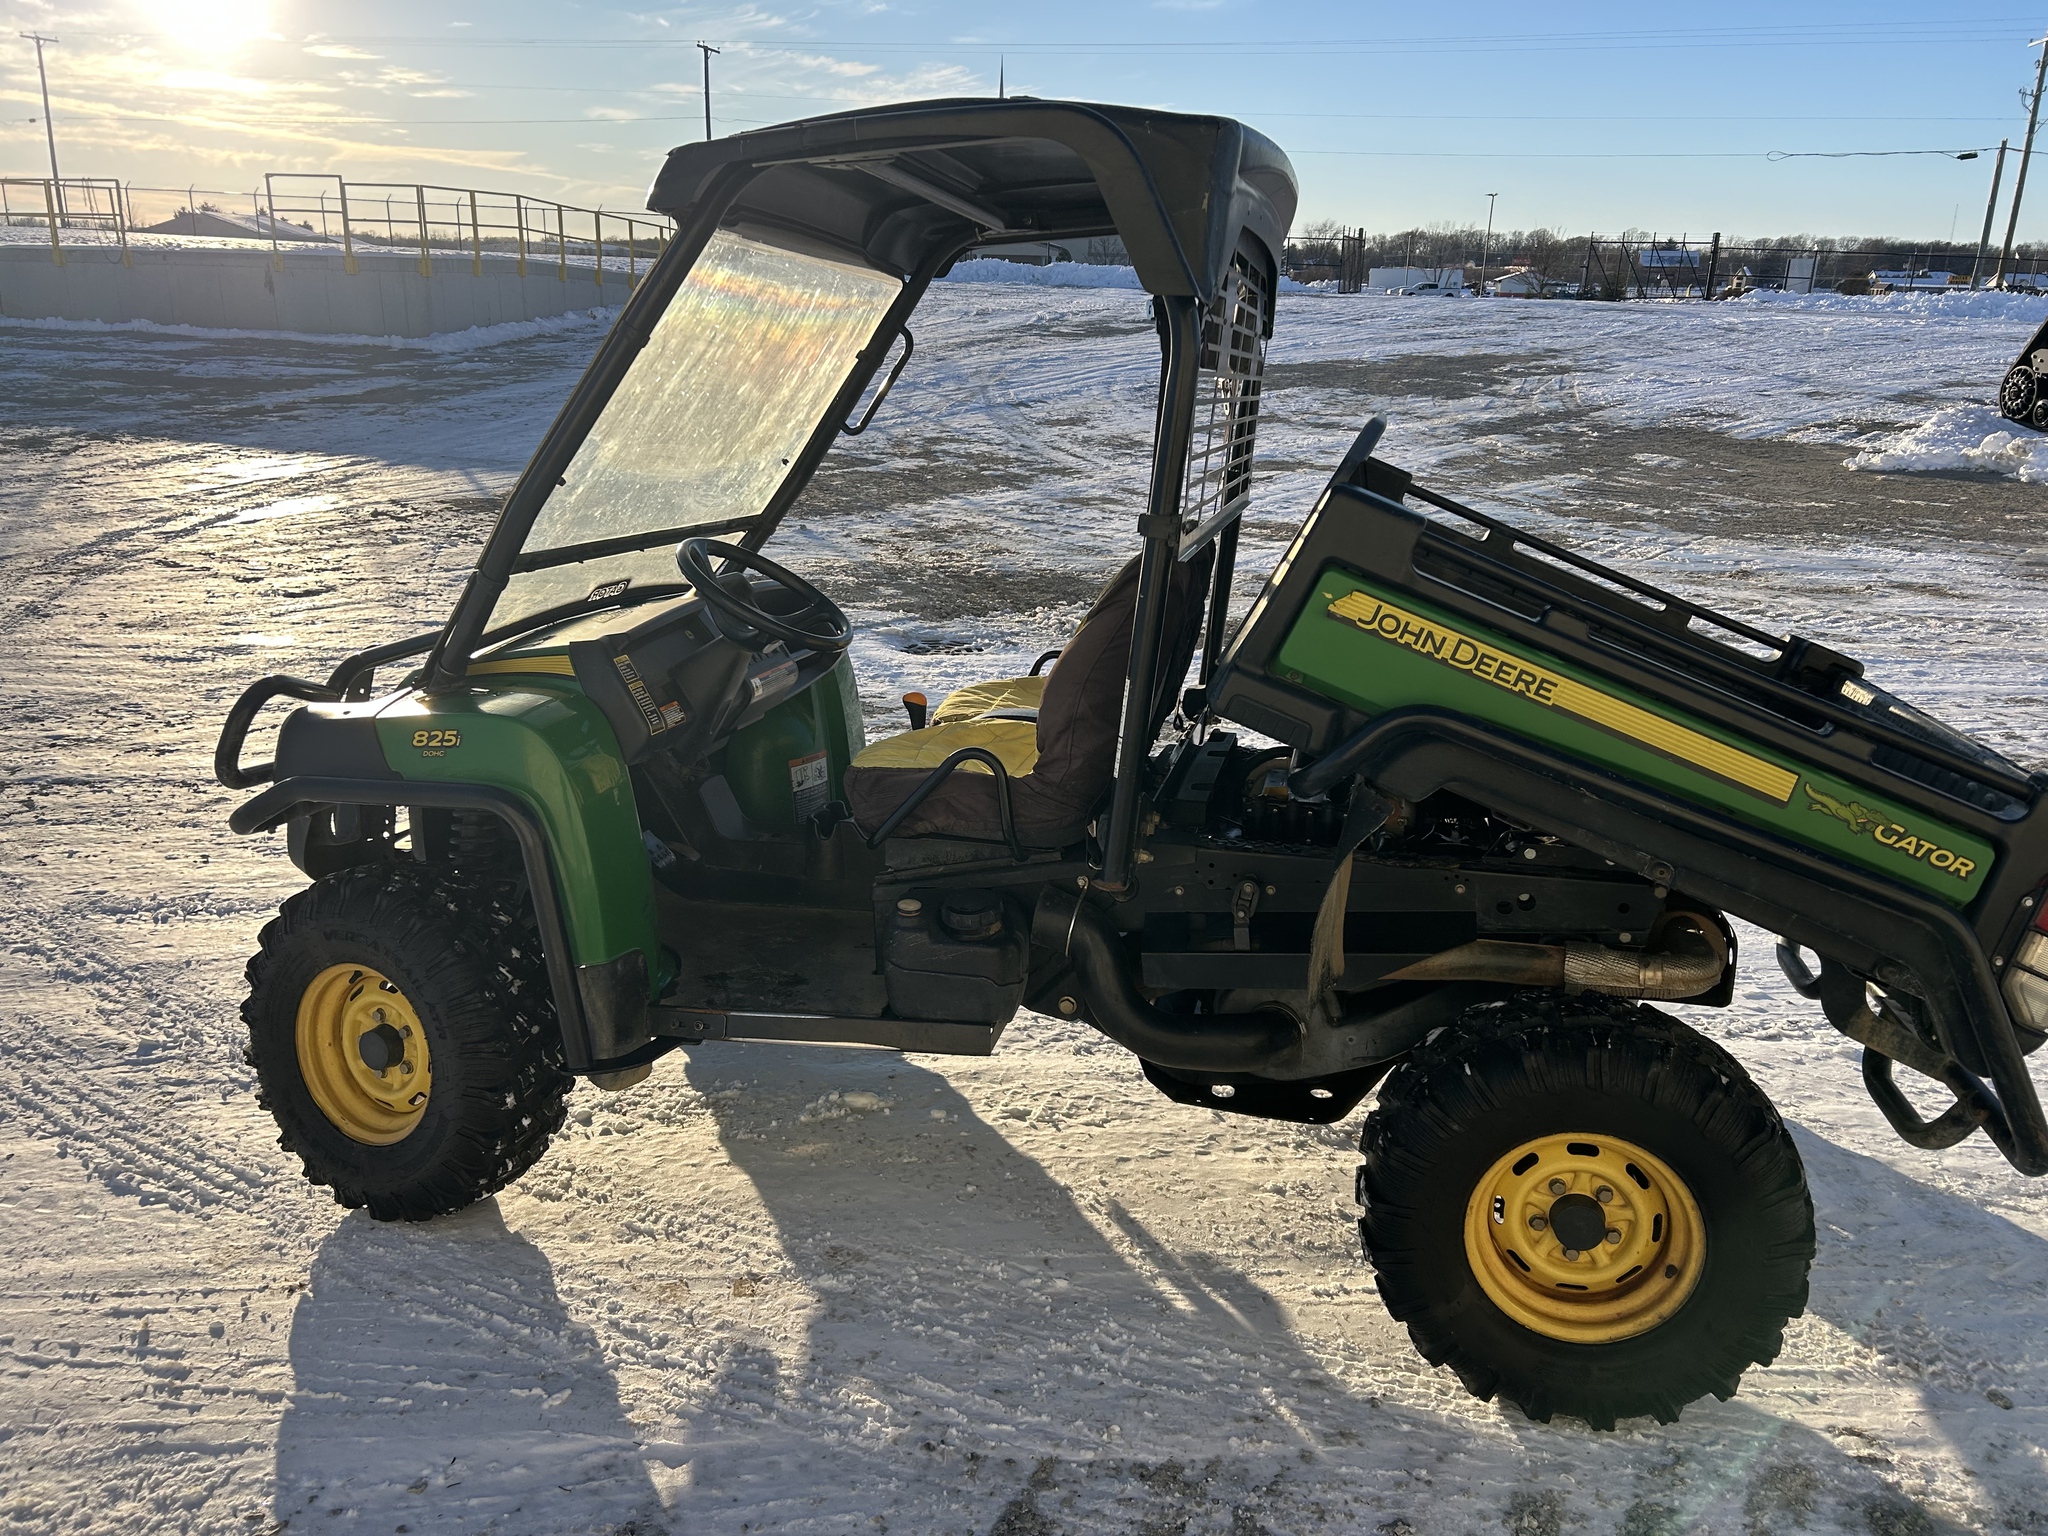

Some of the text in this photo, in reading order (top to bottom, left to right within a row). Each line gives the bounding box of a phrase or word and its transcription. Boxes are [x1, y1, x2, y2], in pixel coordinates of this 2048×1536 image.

[1356, 604, 1559, 702] JOHN DEERE
[412, 730, 461, 747] 825i
[1874, 823, 1976, 878] GATOR
